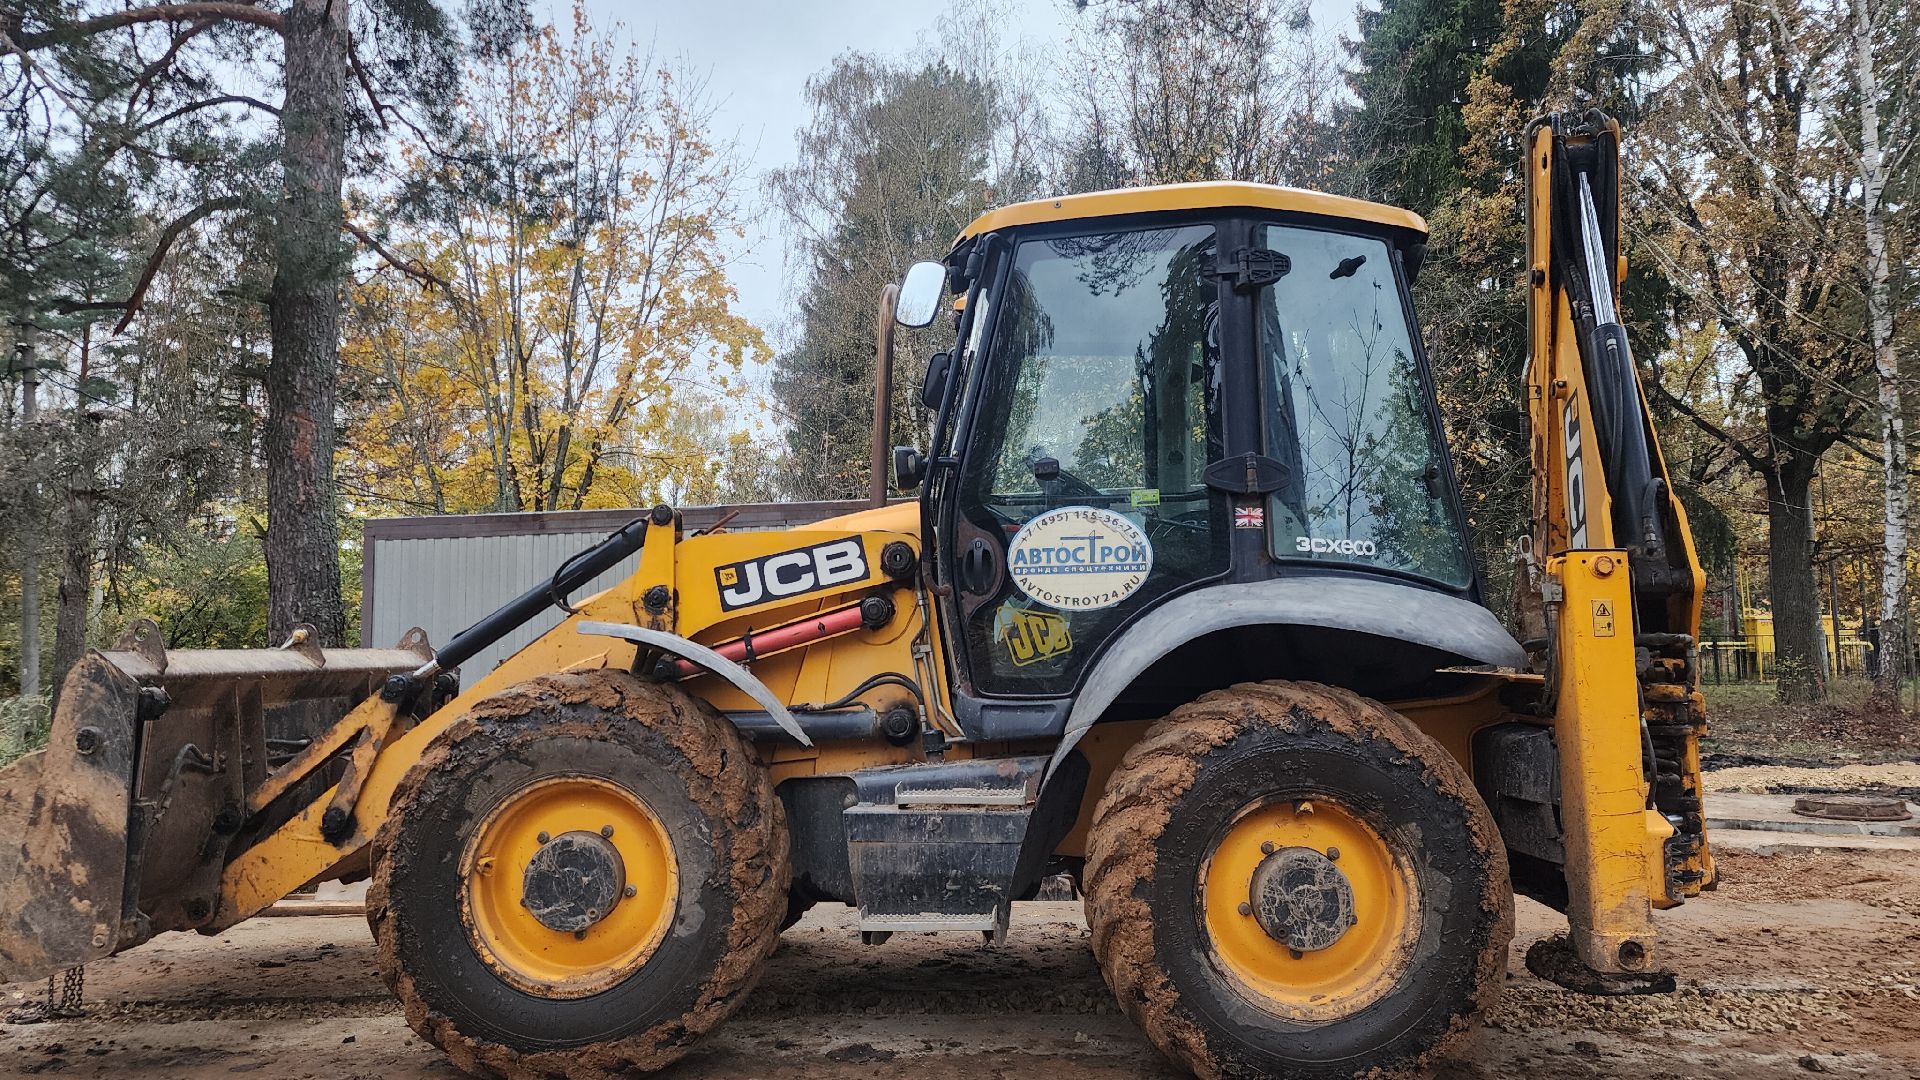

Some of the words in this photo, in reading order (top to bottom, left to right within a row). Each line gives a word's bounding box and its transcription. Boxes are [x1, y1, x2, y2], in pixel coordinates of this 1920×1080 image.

[1565, 408, 1587, 549] JC
[1021, 528, 1033, 542] +7
[1035, 512, 1069, 531] (495)
[1013, 531, 1147, 564] АВТОСТРОЙ
[723, 540, 866, 606] JCB
[1015, 566, 1058, 574] аренда
[1064, 565, 1146, 573] спецтехники
[1019, 575, 1140, 606] AVTOSTROY24.RU
